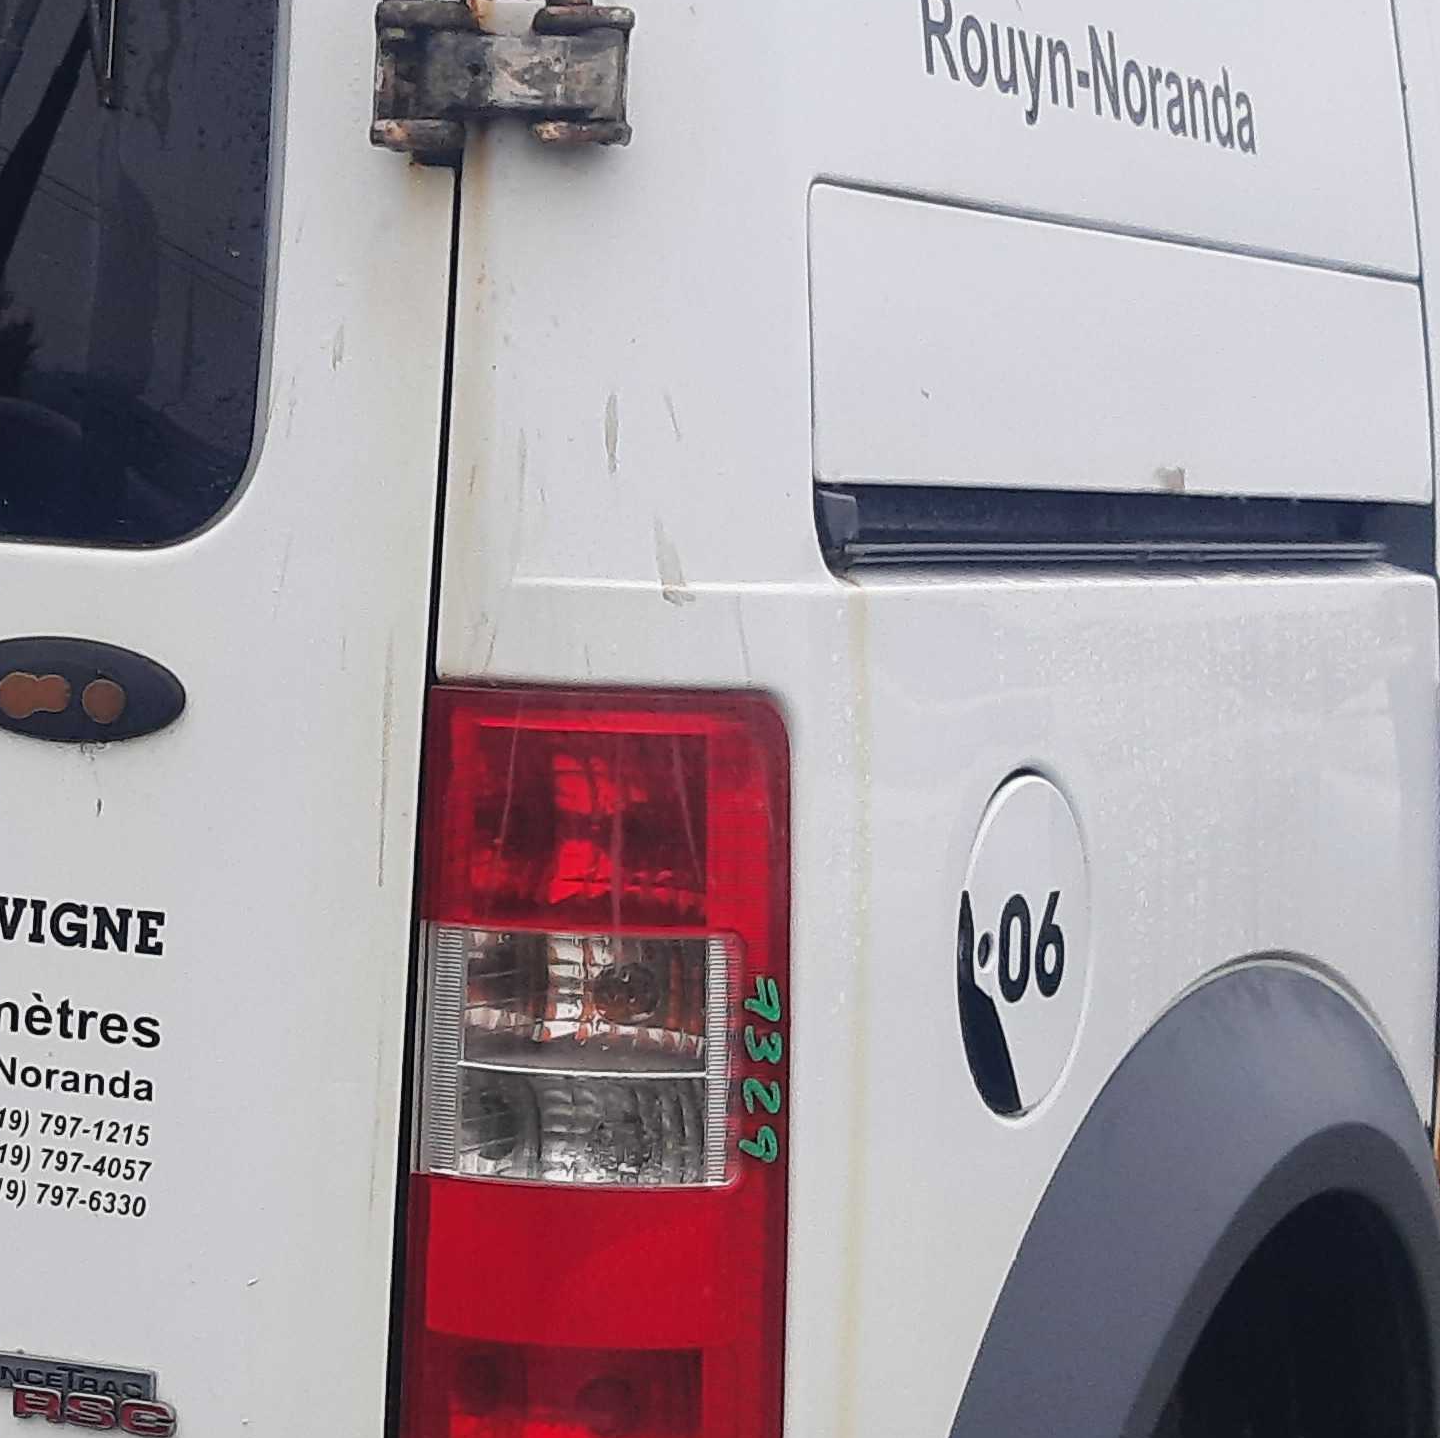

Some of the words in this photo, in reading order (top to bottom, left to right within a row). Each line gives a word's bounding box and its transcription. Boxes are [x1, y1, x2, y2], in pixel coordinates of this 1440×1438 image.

[738, 976, 784, 1163] 7329
[39, 1112, 151, 1148] 797-1215
[40, 1148, 153, 1183] 797-4057
[36, 1183, 147, 1219] 797-6330
[12, 1383, 178, 1438] RSC
